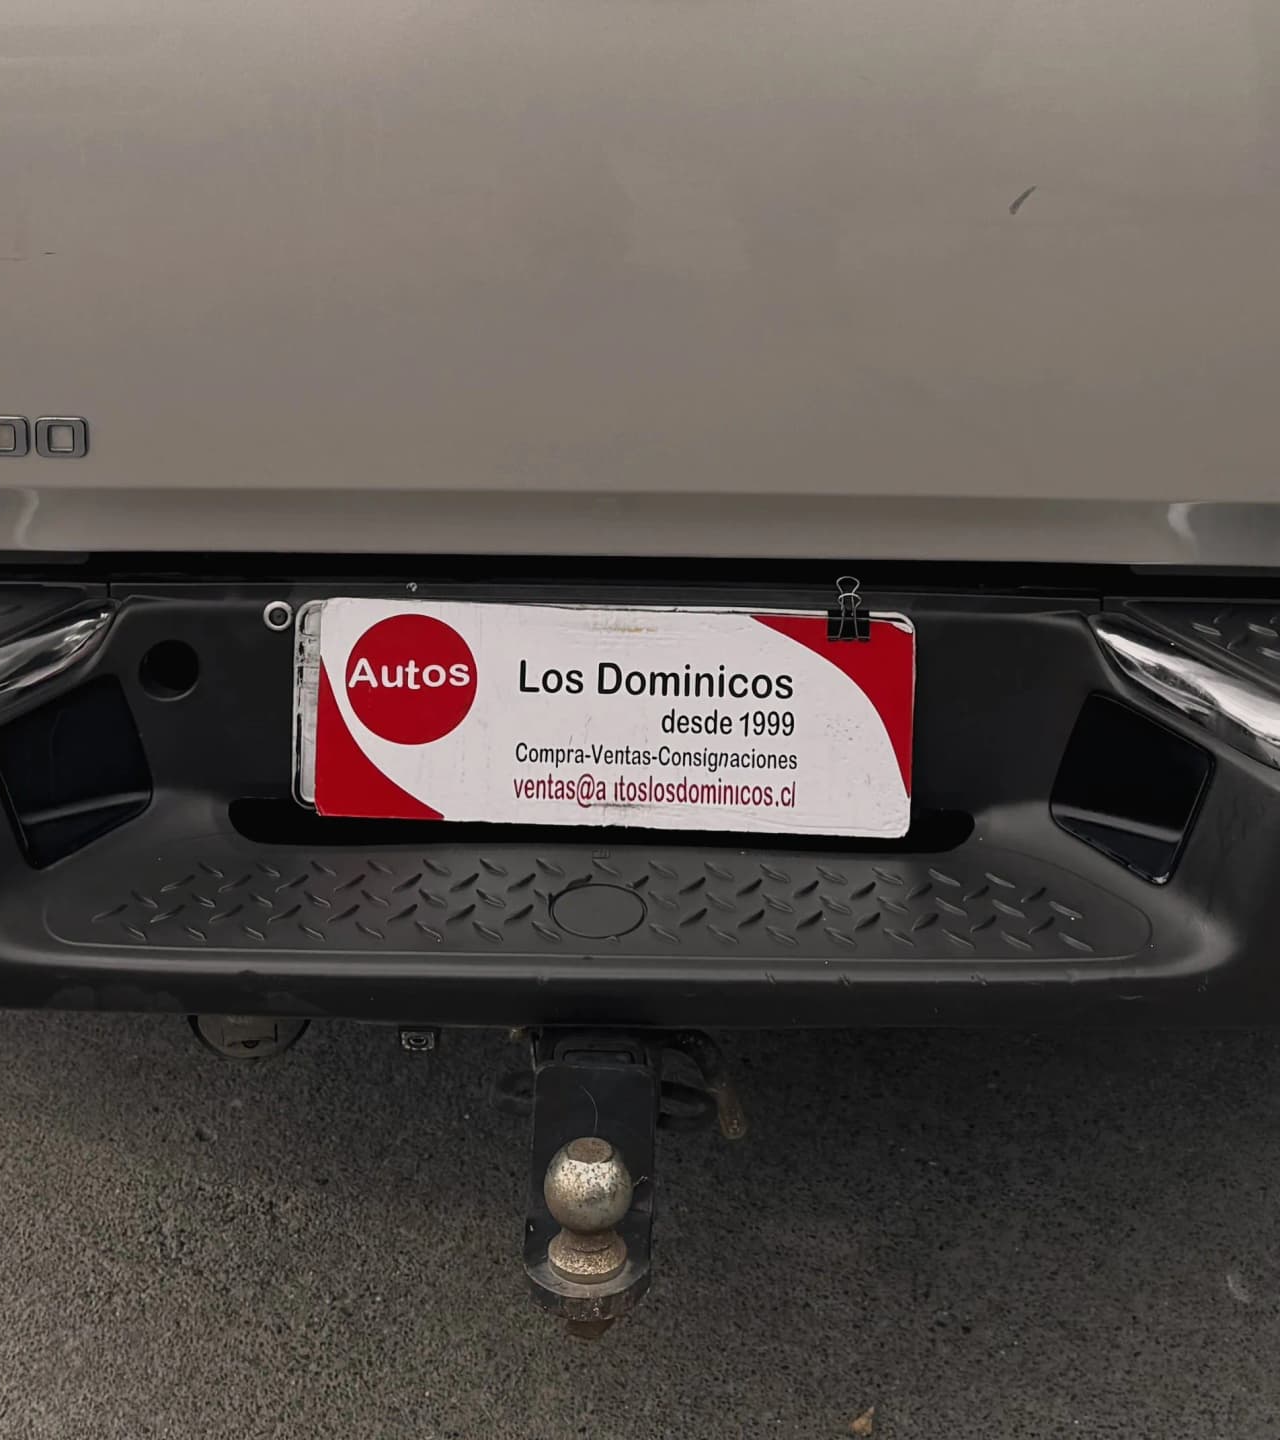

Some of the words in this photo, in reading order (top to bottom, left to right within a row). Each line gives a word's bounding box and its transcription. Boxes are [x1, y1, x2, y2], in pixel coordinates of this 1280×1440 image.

[348, 657, 471, 690] Autos
[519, 659, 584, 694] Los
[597, 662, 794, 700] Dominicos
[661, 708, 733, 735] desde
[739, 710, 795, 737] 1999
[515, 742, 798, 773] Compra-Ventas-Consignaciones
